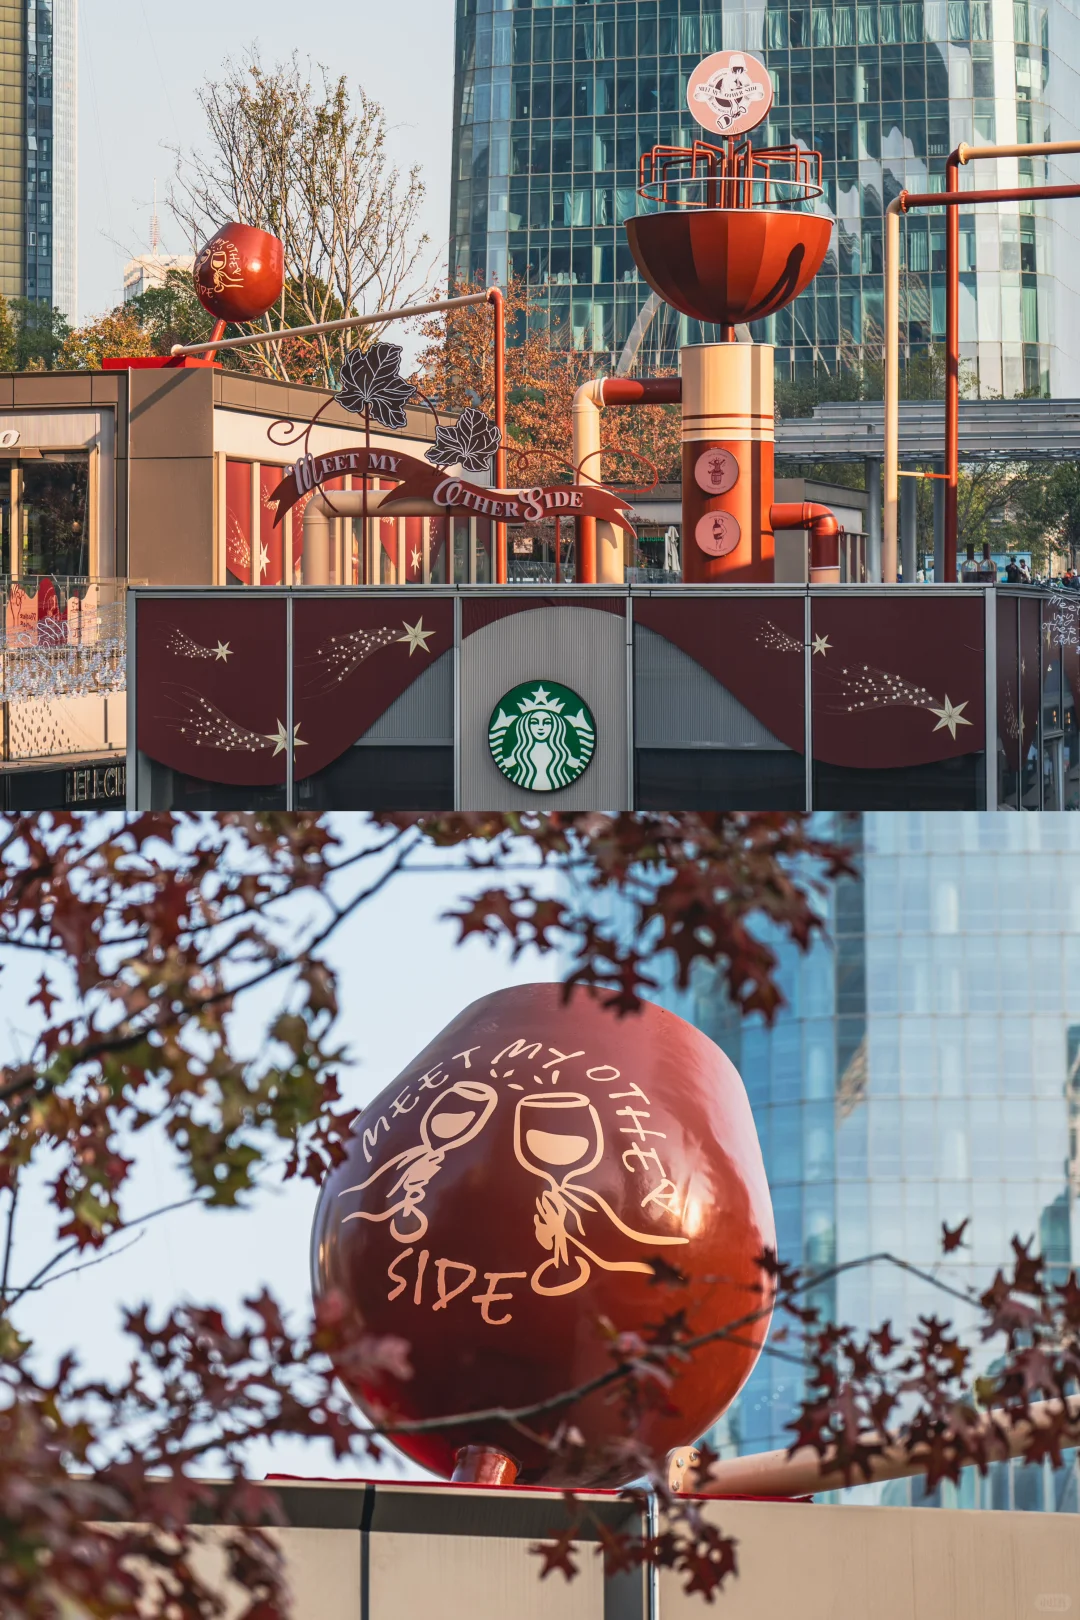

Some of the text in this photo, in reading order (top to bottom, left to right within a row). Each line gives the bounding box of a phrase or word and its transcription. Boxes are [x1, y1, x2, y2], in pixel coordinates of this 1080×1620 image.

[724, 90, 744, 98] OTHER
[226, 243, 242, 276] OTHER
[284, 452, 403, 495] MEET MY
[432, 476, 584, 522] OTHER SIDE
[362, 1038, 682, 1217] MEET MY OTHER
[386, 1247, 528, 1326] SIDE
